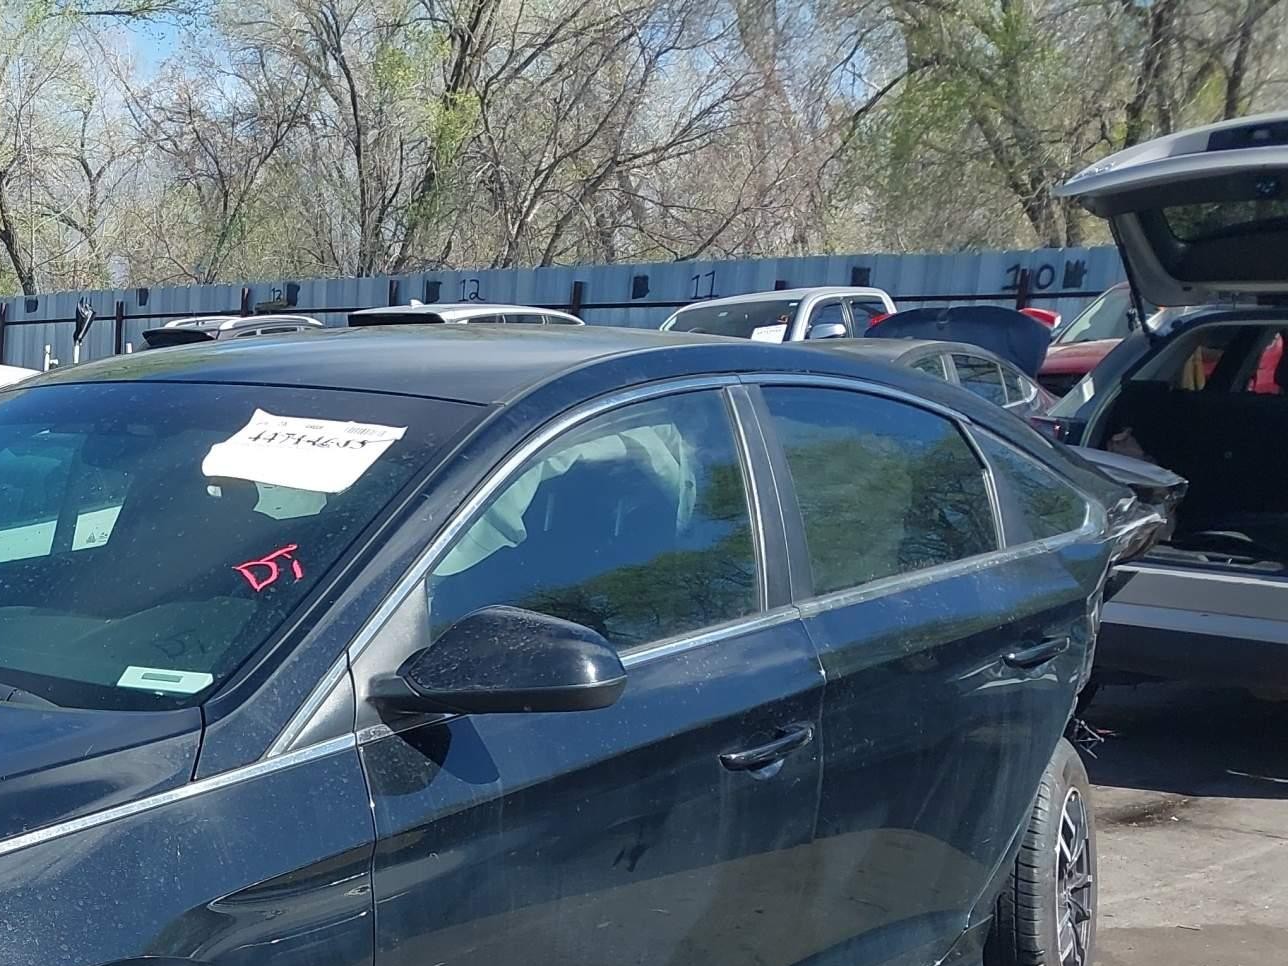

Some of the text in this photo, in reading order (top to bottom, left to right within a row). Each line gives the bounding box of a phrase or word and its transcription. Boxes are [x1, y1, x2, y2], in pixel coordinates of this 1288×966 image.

[459, 279, 485, 302] 12
[689, 269, 720, 300] 11
[1001, 262, 1056, 291] 10
